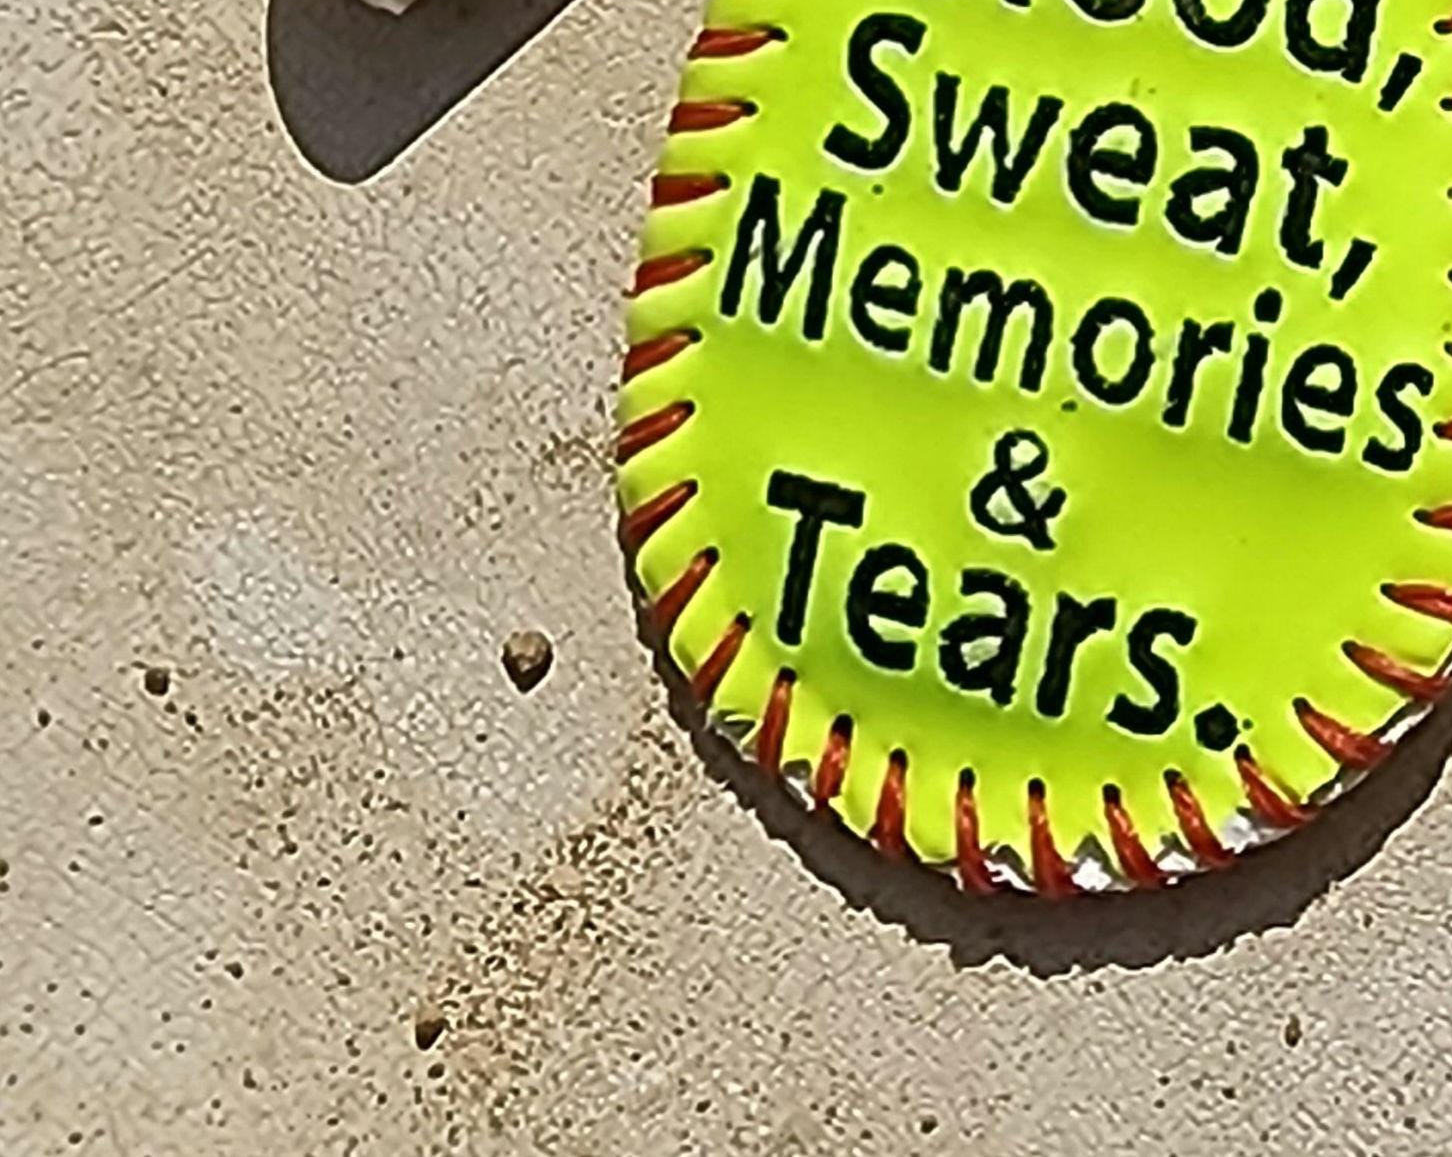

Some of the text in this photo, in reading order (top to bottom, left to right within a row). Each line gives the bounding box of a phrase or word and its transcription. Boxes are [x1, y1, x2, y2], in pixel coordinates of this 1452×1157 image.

[822, 12, 1378, 301] Sweat,
[718, 173, 1435, 473] Memories
[766, 469, 1241, 752] Tears.
[969, 429, 1067, 551] &
